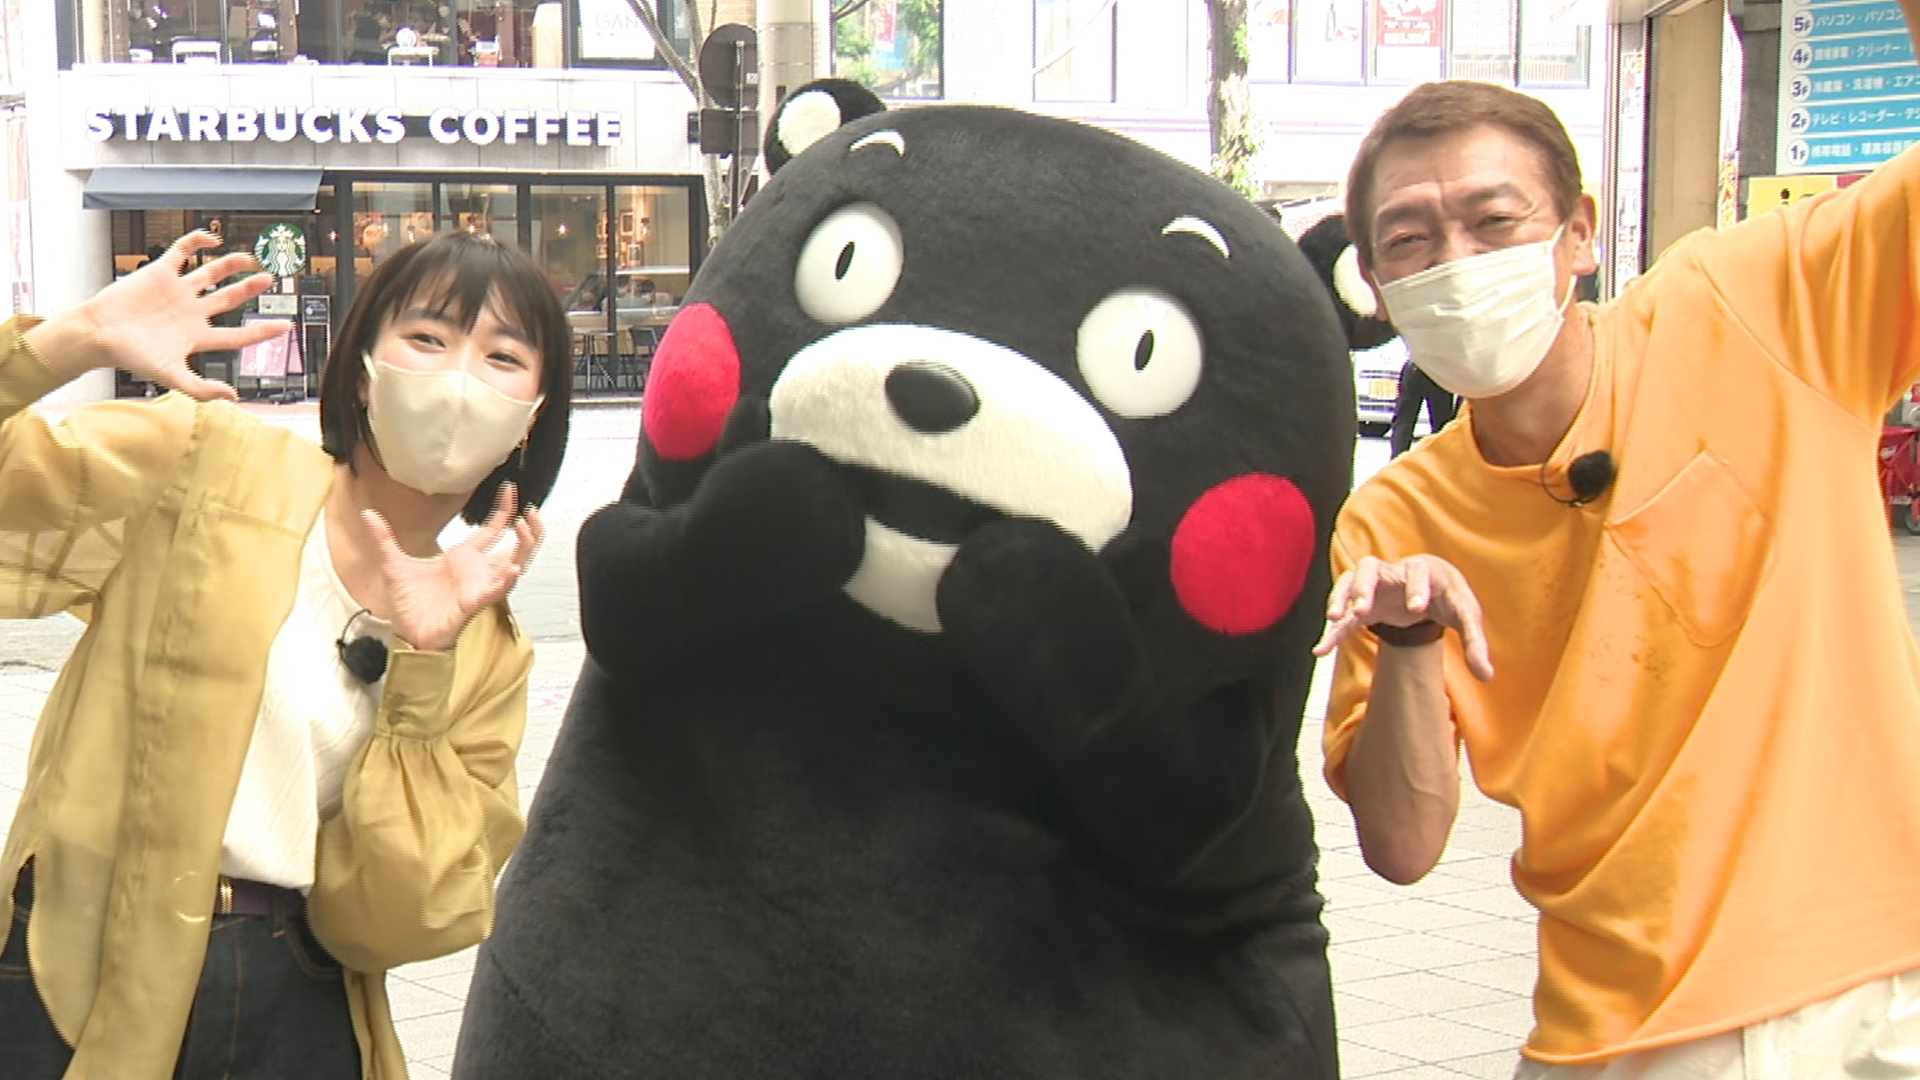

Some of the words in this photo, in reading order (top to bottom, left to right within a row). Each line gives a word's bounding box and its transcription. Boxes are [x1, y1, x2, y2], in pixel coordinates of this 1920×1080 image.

[1793, 16, 1810, 32] 5F
[1792, 48, 1809, 64] 4F
[1792, 80, 1808, 97] 3F
[85, 104, 406, 143] STARBUCKS
[428, 106, 622, 146] COFFEE
[1791, 113, 1808, 128] 2F
[1790, 145, 1806, 160] 1F
